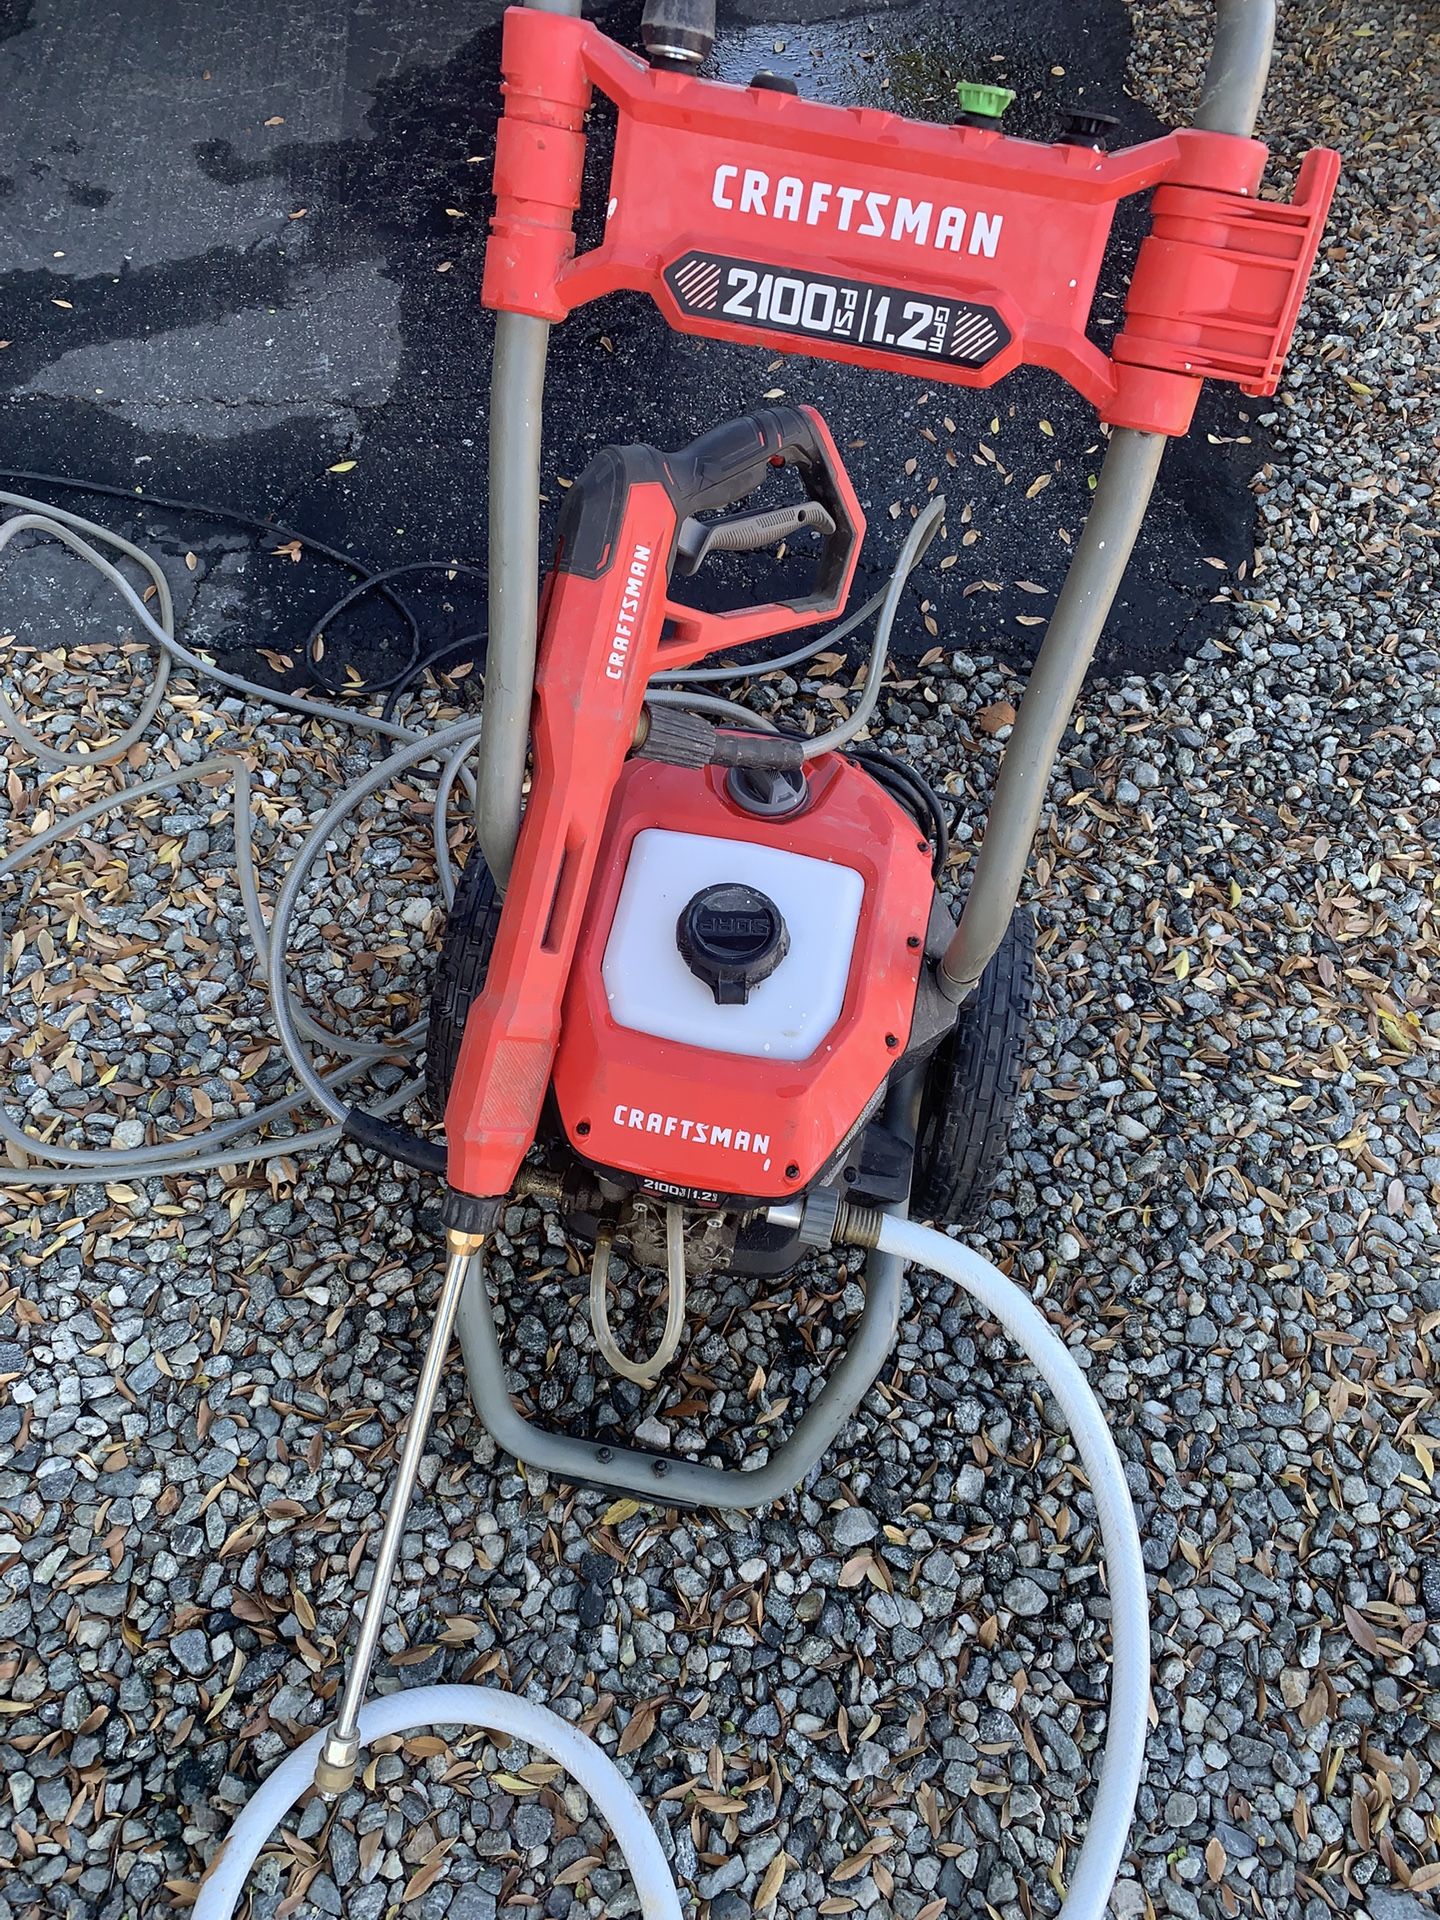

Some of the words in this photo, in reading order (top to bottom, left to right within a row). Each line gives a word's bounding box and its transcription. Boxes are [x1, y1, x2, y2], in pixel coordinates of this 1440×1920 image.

[712, 165, 1003, 258] CRAFTSMAN
[722, 268, 837, 332] 2100
[832, 288, 858, 336] PSI
[872, 296, 934, 350] 1.2
[928, 306, 950, 353] GPM
[606, 544, 651, 679] CRAFTSMAN
[700, 917, 769, 936] SOAP
[613, 1105, 770, 1154] CRAFTSMAN
[643, 1179, 679, 1196] 2100
[693, 1190, 712, 1201] 1.2
